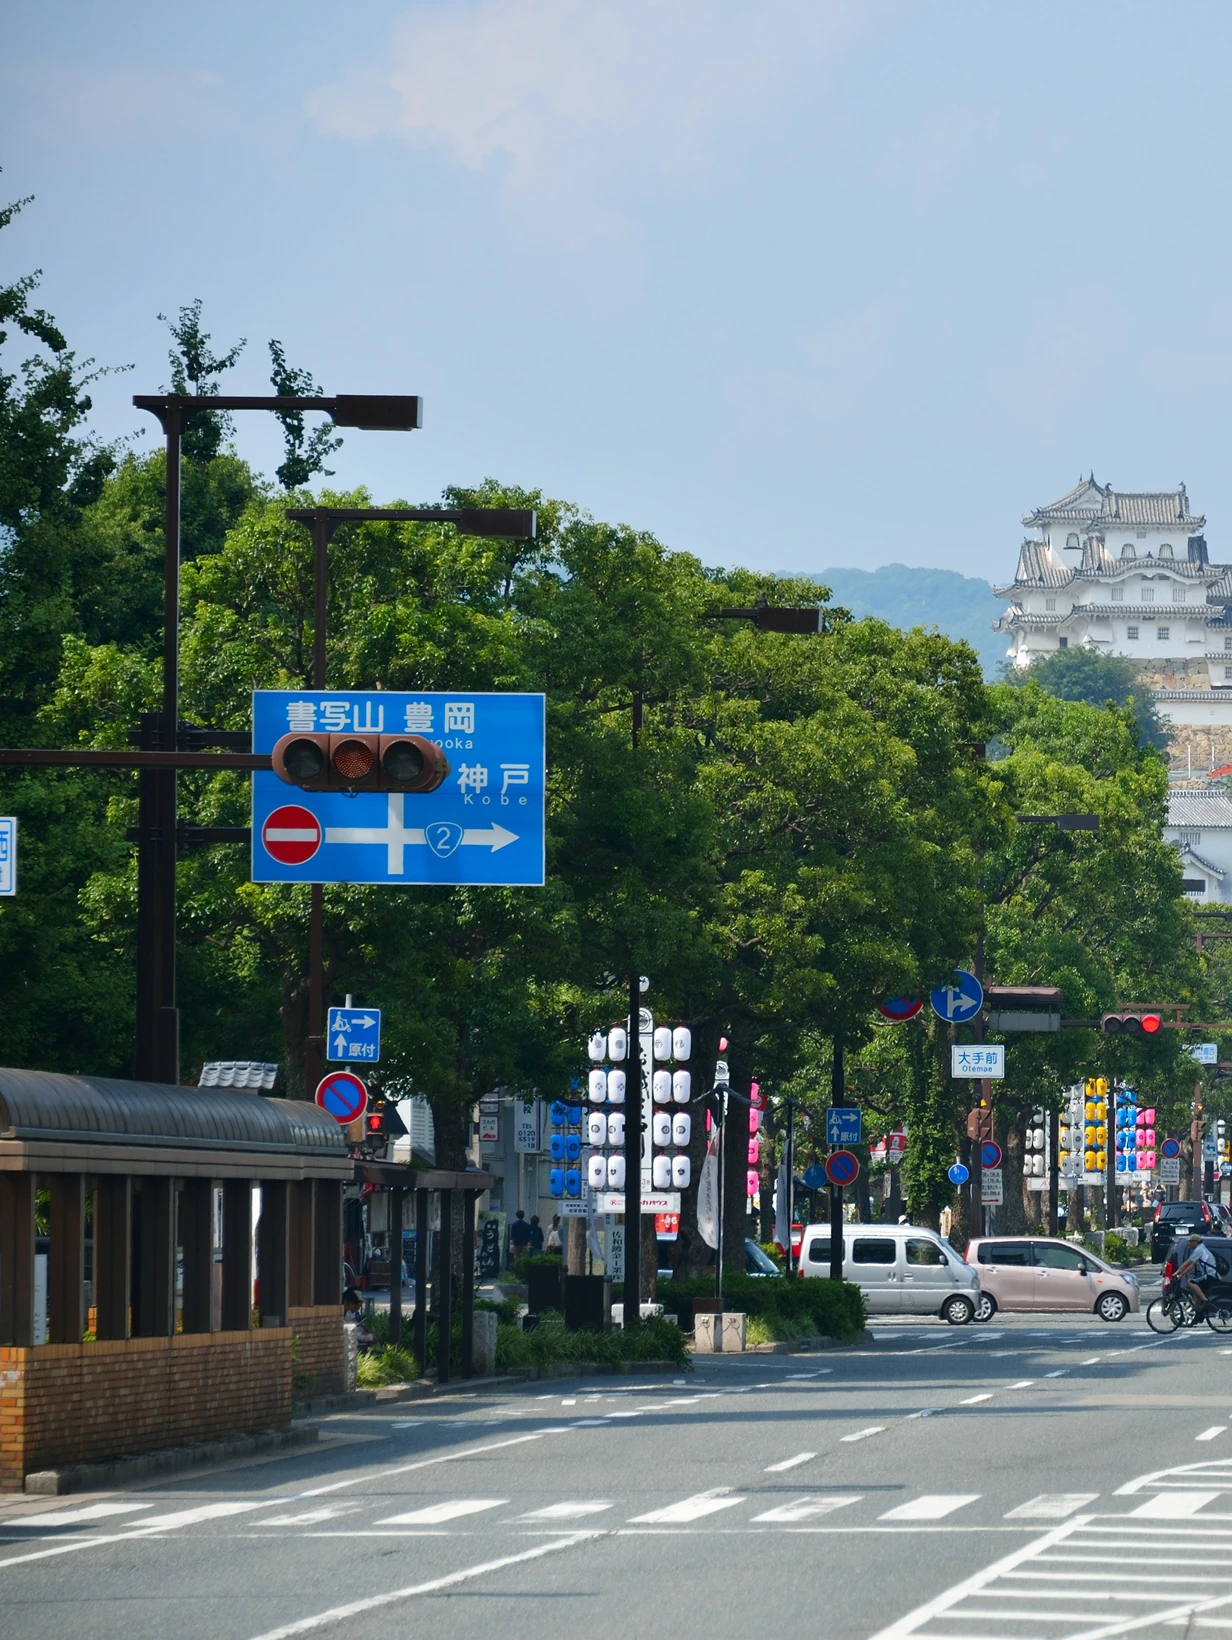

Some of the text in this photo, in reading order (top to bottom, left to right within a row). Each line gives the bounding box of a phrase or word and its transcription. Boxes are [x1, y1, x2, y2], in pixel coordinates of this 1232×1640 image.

[286, 701, 475, 733] 書写山 豊岡
[456, 763, 530, 794] 神戸
[463, 793, 528, 806] Kobe
[436, 827, 452, 849] 2
[349, 1042, 376, 1058] 原付
[958, 1051, 998, 1064] 大手前
[841, 1131, 859, 1142] 原付
